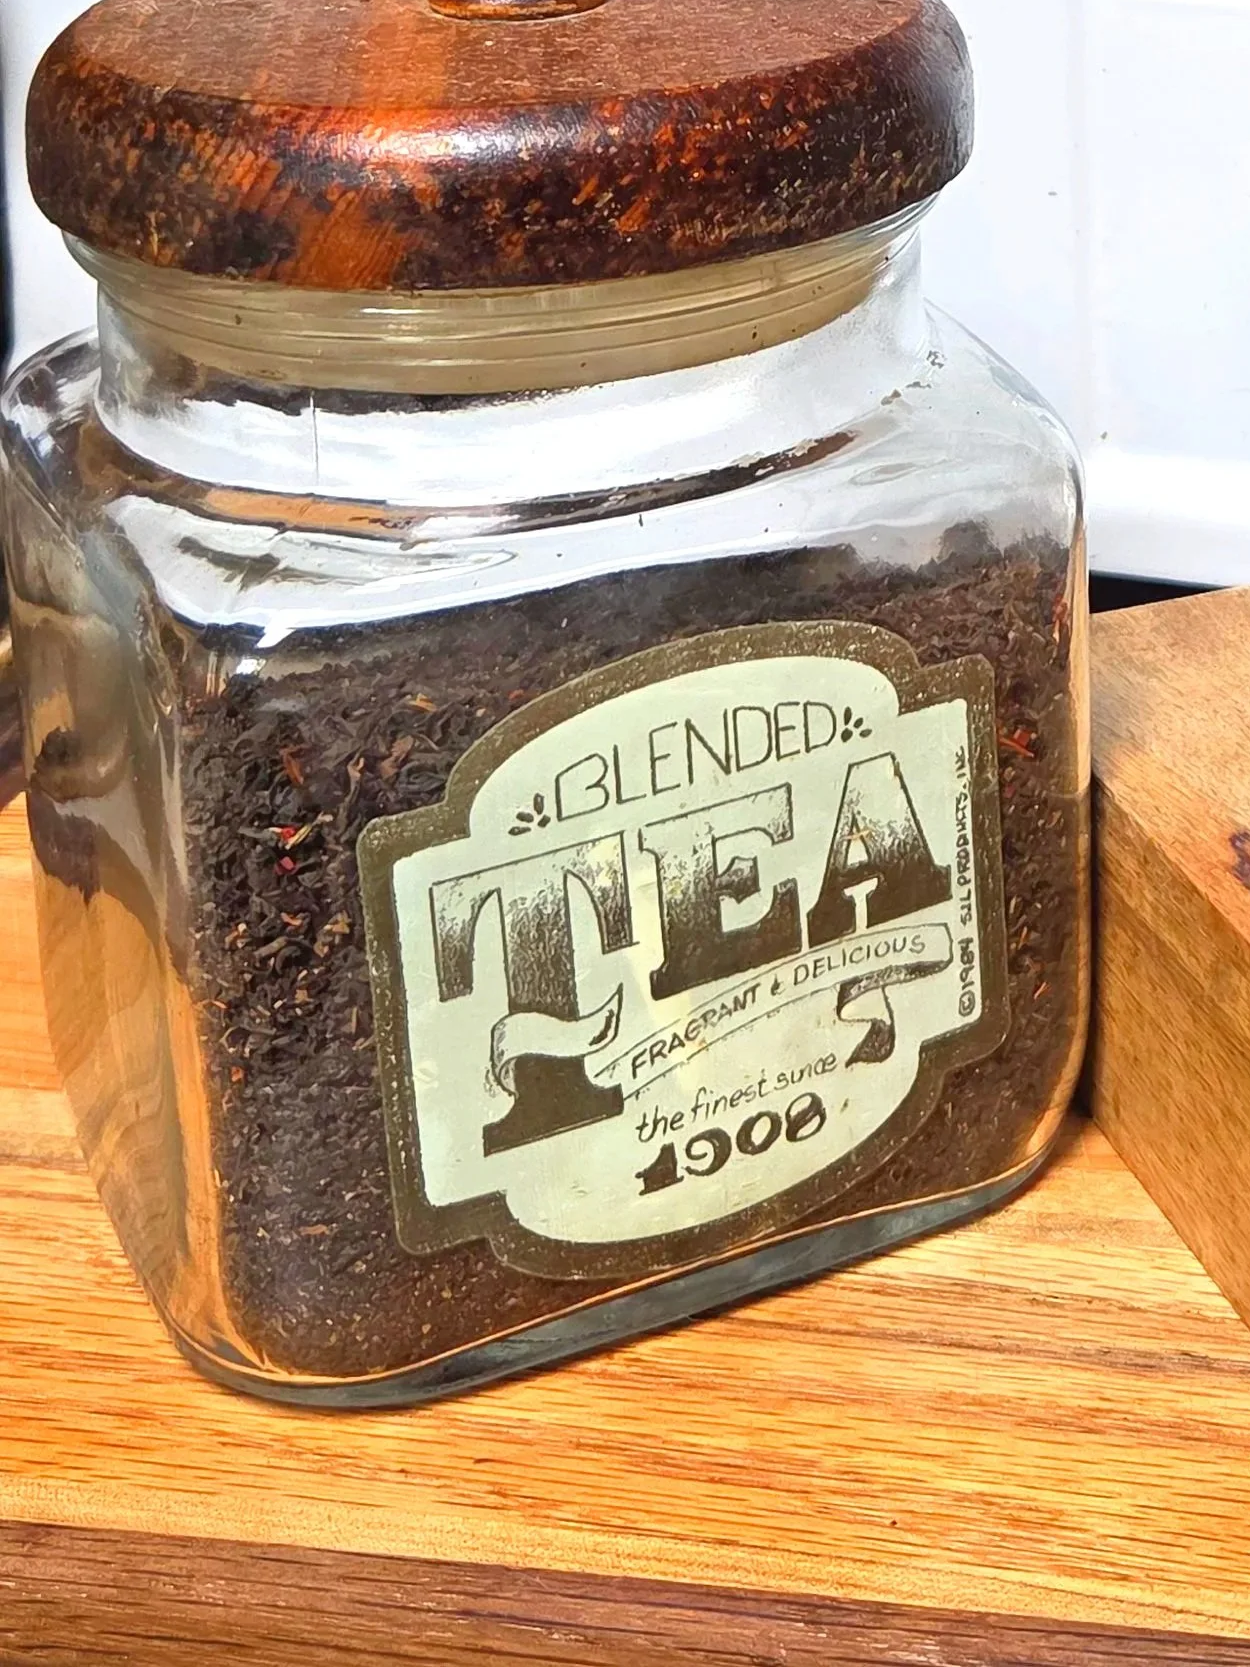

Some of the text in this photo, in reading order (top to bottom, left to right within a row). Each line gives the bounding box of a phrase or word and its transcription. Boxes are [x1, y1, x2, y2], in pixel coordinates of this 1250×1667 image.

[555, 700, 837, 822] BLENDED
[429, 752, 953, 1157] TEA
[631, 934, 926, 1079] FRAGRANT & DELICIOUS
[635, 1053, 839, 1143] the finest since
[635, 1092, 827, 1196] 1908
